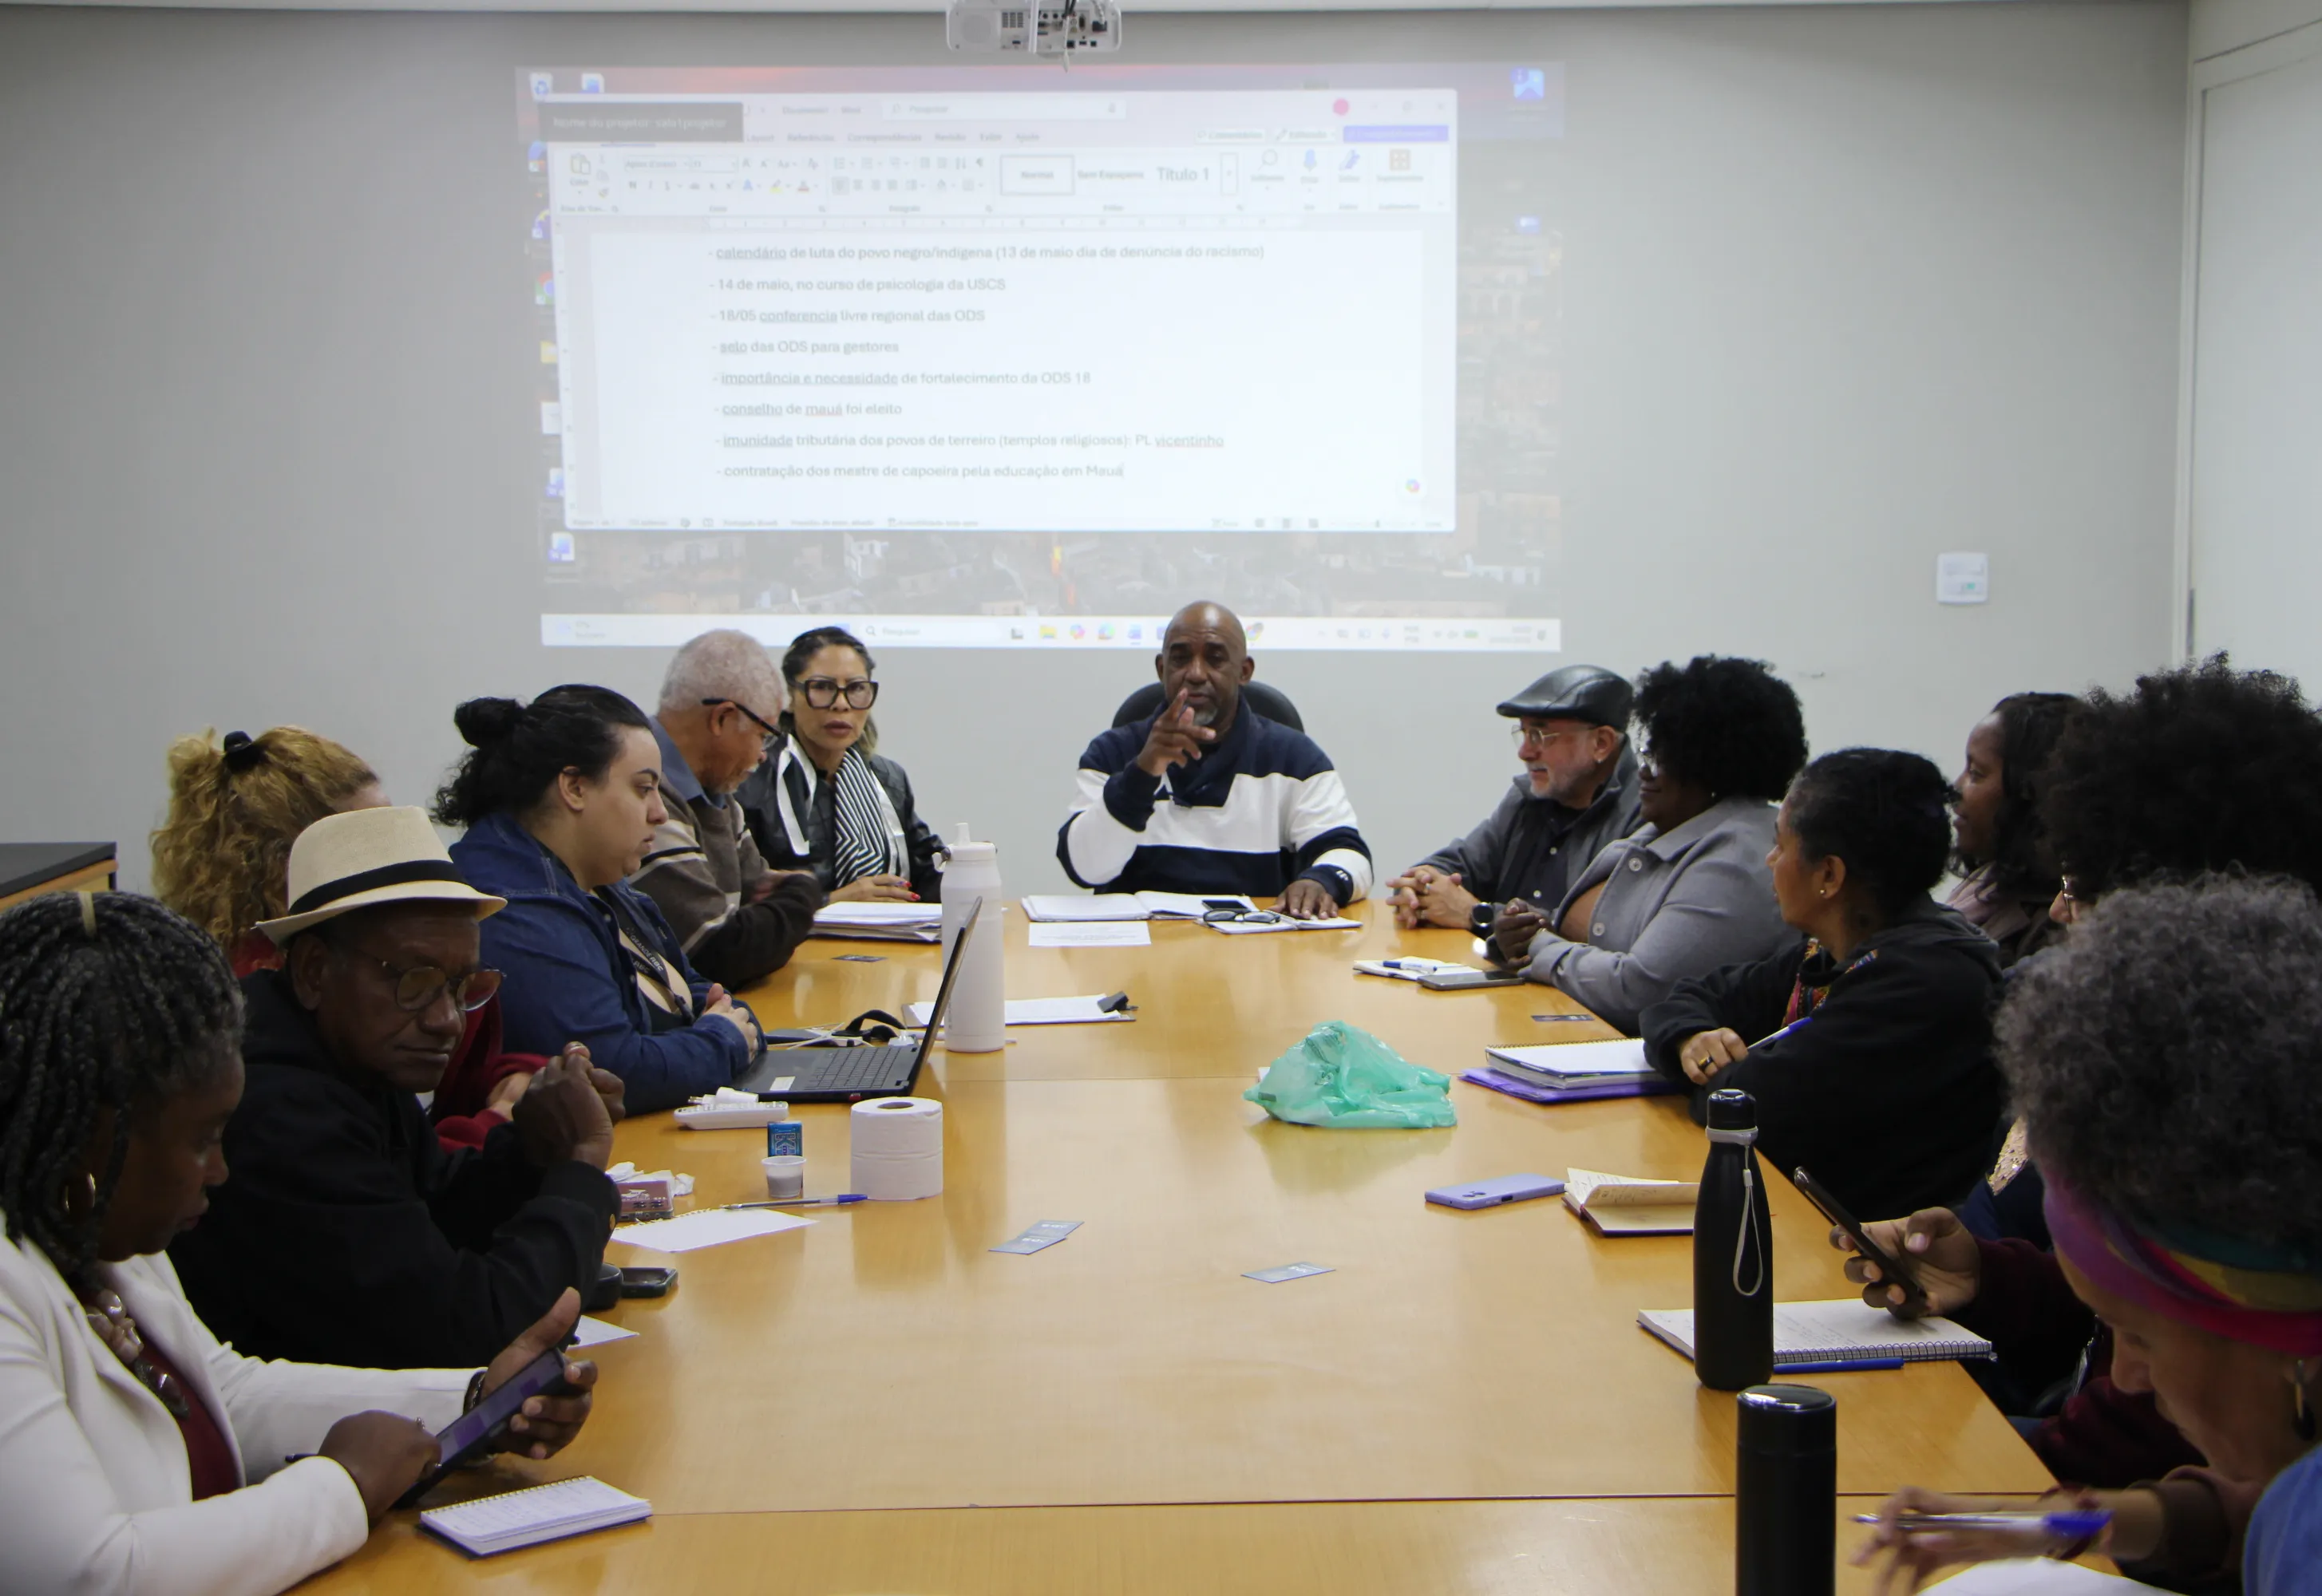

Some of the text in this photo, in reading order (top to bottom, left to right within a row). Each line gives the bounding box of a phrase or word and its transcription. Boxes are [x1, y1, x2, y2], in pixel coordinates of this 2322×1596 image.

[1157, 167, 1210, 182] Título 1
[716, 246, 786, 259] calendário
[790, 246, 806, 259] de
[809, 246, 835, 259] luta
[838, 246, 855, 259] do
[858, 248, 890, 261] povo
[995, 246, 1017, 261] (13
[1020, 246, 1037, 259] de
[1040, 247, 1074, 259] maio
[1076, 246, 1097, 259] dia
[1100, 246, 1117, 258] de
[1120, 245, 1182, 258] denúncia
[1185, 245, 1202, 258] do
[1205, 246, 1264, 260] racismo)
[718, 279, 734, 290] 14
[737, 278, 754, 290] de
[757, 279, 793, 292] maio,
[797, 281, 813, 290] no
[817, 281, 853, 290] curso
[856, 278, 874, 290] de
[877, 278, 943, 293] psicologia
[947, 278, 964, 290] da
[967, 279, 1006, 290] USCS
[719, 310, 757, 321] 18/05
[760, 310, 837, 322] conferencia
[841, 310, 868, 321] livre
[871, 310, 924, 323] regional
[927, 310, 951, 321] das
[955, 310, 986, 321] ODS
[720, 341, 748, 354] selo
[751, 341, 774, 353] das
[777, 341, 808, 353] ODS
[811, 343, 840, 355] para
[843, 342, 900, 356] gestores
[721, 372, 800, 386] importância
[803, 375, 812, 385] e
[815, 372, 898, 385] necessidade
[901, 372, 917, 384] de
[920, 372, 1019, 385] fortalecimento
[1021, 372, 1038, 384] da
[1041, 373, 1071, 384] ODS
[1075, 372, 1091, 384] 18
[722, 404, 783, 416] conselho
[786, 403, 802, 415] de
[805, 403, 843, 416] mauá
[846, 403, 862, 414] foi
[865, 403, 903, 414] eleito
[723, 434, 793, 447] imunidade
[796, 434, 856, 446] tributária
[860, 434, 883, 446] dos
[886, 437, 926, 448] povos
[929, 434, 945, 446] de
[948, 434, 995, 446] terreiro
[999, 434, 1057, 449] (templos
[1155, 435, 1224, 447] vicentinho
[725, 464, 804, 479] contratação
[806, 465, 830, 477] dos
[833, 467, 879, 477] mestre
[882, 465, 899, 477] de
[902, 466, 959, 479] capoeira
[962, 465, 991, 479] pela
[994, 465, 1059, 479] educação
[1062, 468, 1083, 477] em
[1086, 464, 1123, 477] Mauá
